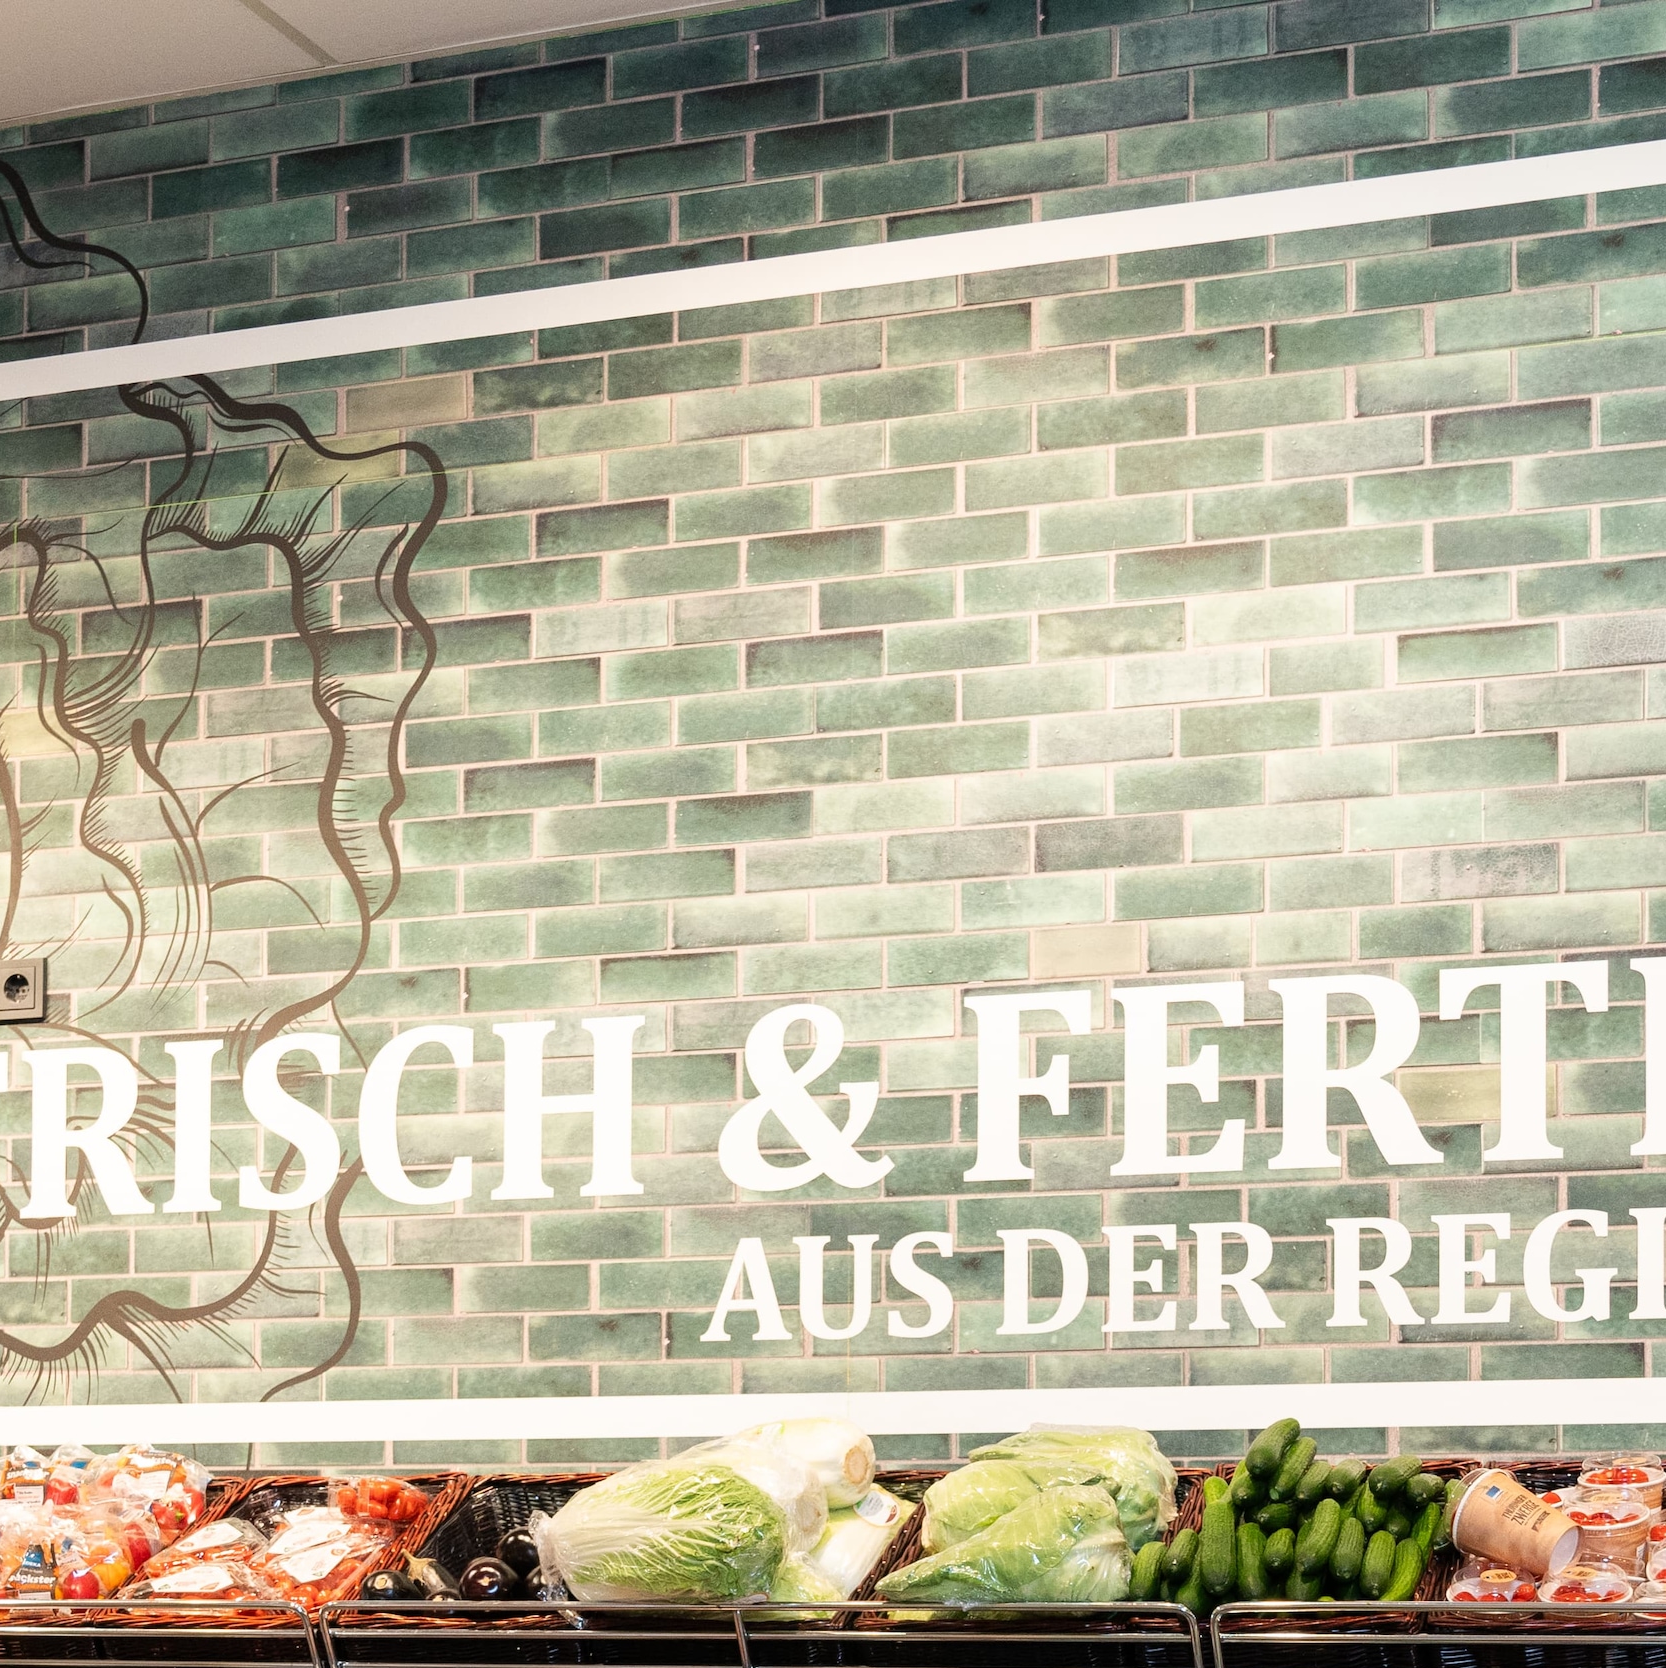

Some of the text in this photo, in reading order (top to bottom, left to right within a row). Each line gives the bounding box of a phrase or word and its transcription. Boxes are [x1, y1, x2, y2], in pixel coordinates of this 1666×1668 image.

[718, 1003, 894, 1192] &
[701, 1233, 959, 1343] AUS
[995, 1221, 1279, 1336] DER
